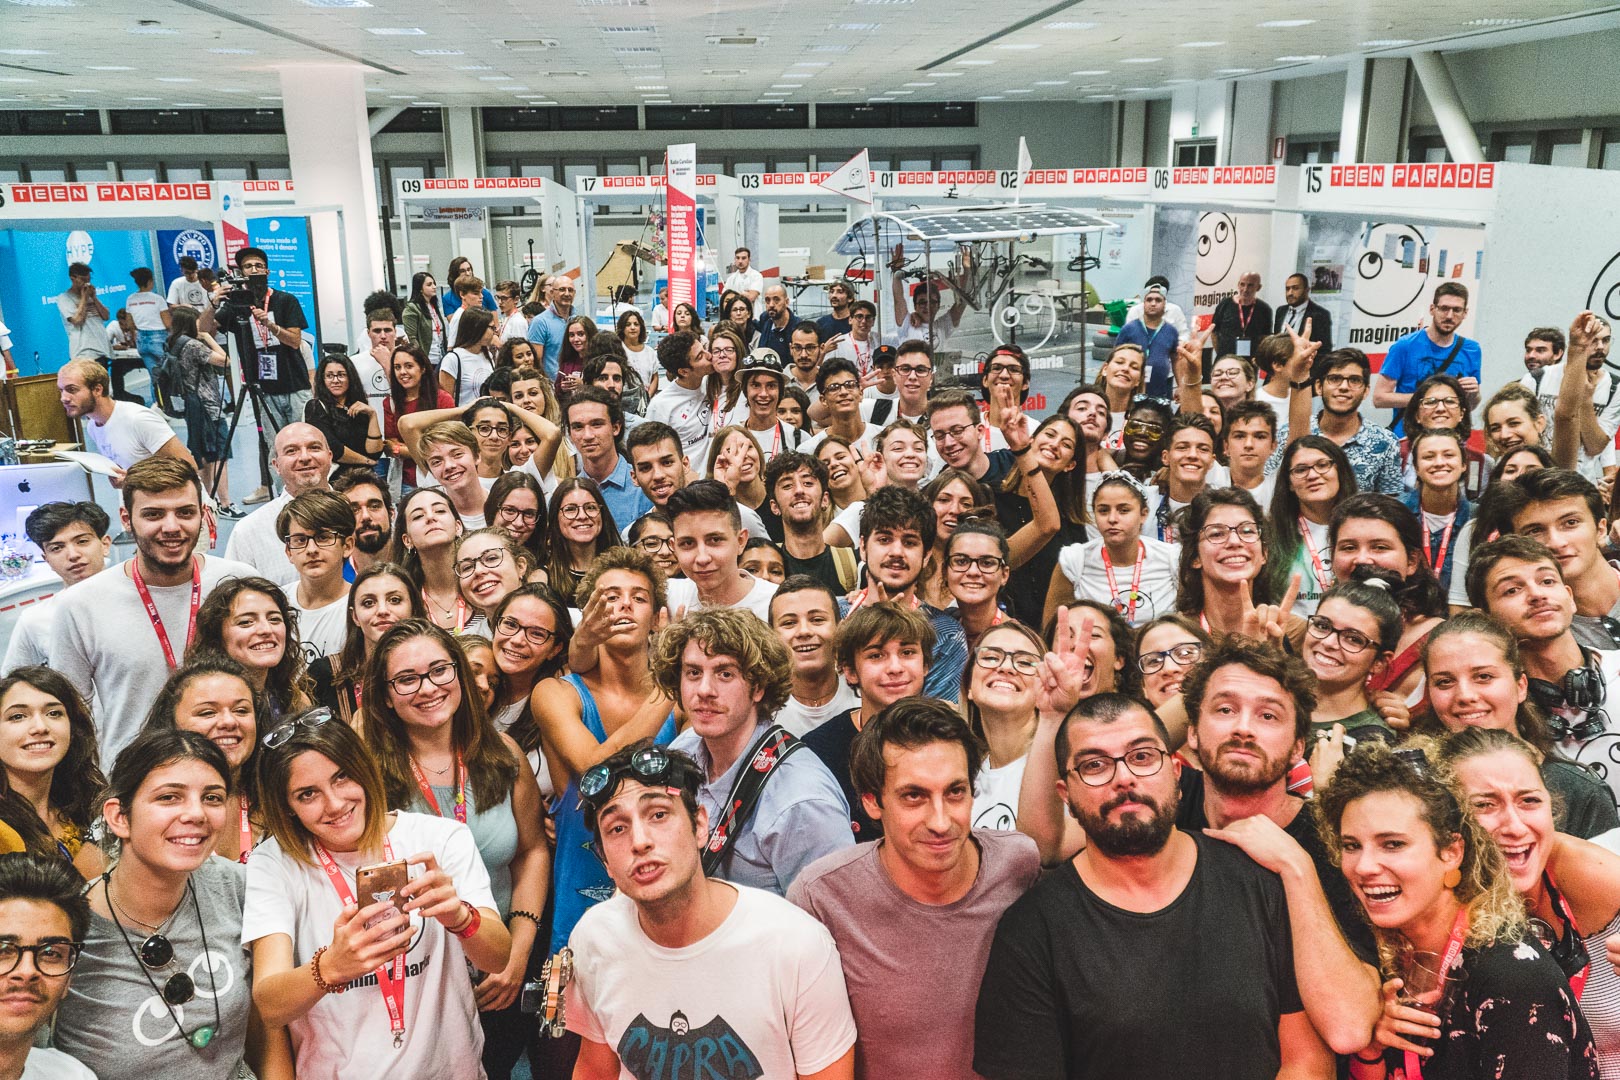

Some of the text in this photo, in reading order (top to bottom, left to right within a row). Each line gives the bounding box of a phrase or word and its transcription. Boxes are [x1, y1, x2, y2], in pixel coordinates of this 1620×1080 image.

[402, 179, 540, 192] 09 TEEN PARADE
[582, 178, 596, 191] 17
[604, 178, 644, 186] TEEN
[742, 174, 759, 188] 03
[764, 174, 804, 183] TEEN
[881, 172, 996, 188] 01 TEEN PARADE
[1000, 169, 1146, 188] 02 TEEN PARADE
[1154, 168, 1275, 189] 06 TEEN PARADE
[1306, 166, 1494, 193] 15 TEEN PARADE
[14, 187, 87, 201] TEEN
[98, 185, 210, 200] PARADE
[179, 233, 206, 246] GRUPPO
[622, 1026, 755, 1080] CAPRA
